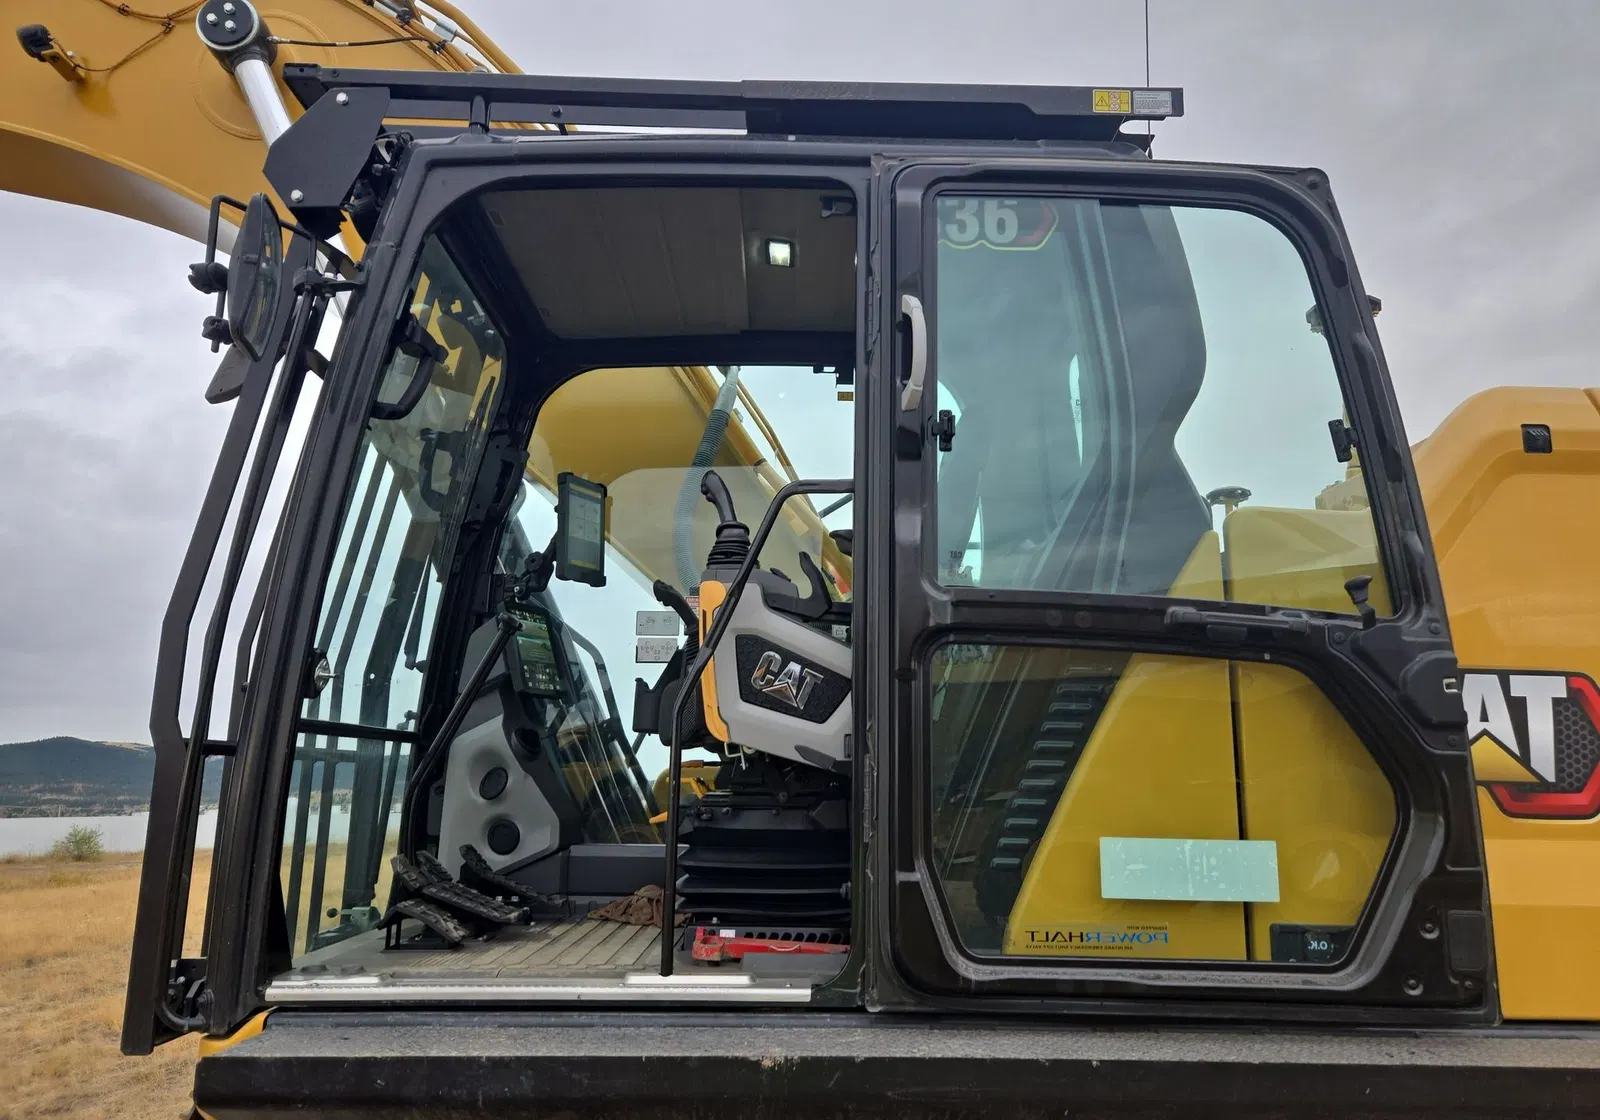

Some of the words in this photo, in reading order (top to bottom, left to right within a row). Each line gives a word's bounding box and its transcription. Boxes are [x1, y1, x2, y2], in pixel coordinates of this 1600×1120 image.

[938, 198, 1018, 244] 36
[751, 651, 824, 710] CAT
[1461, 673, 1568, 783] AT
